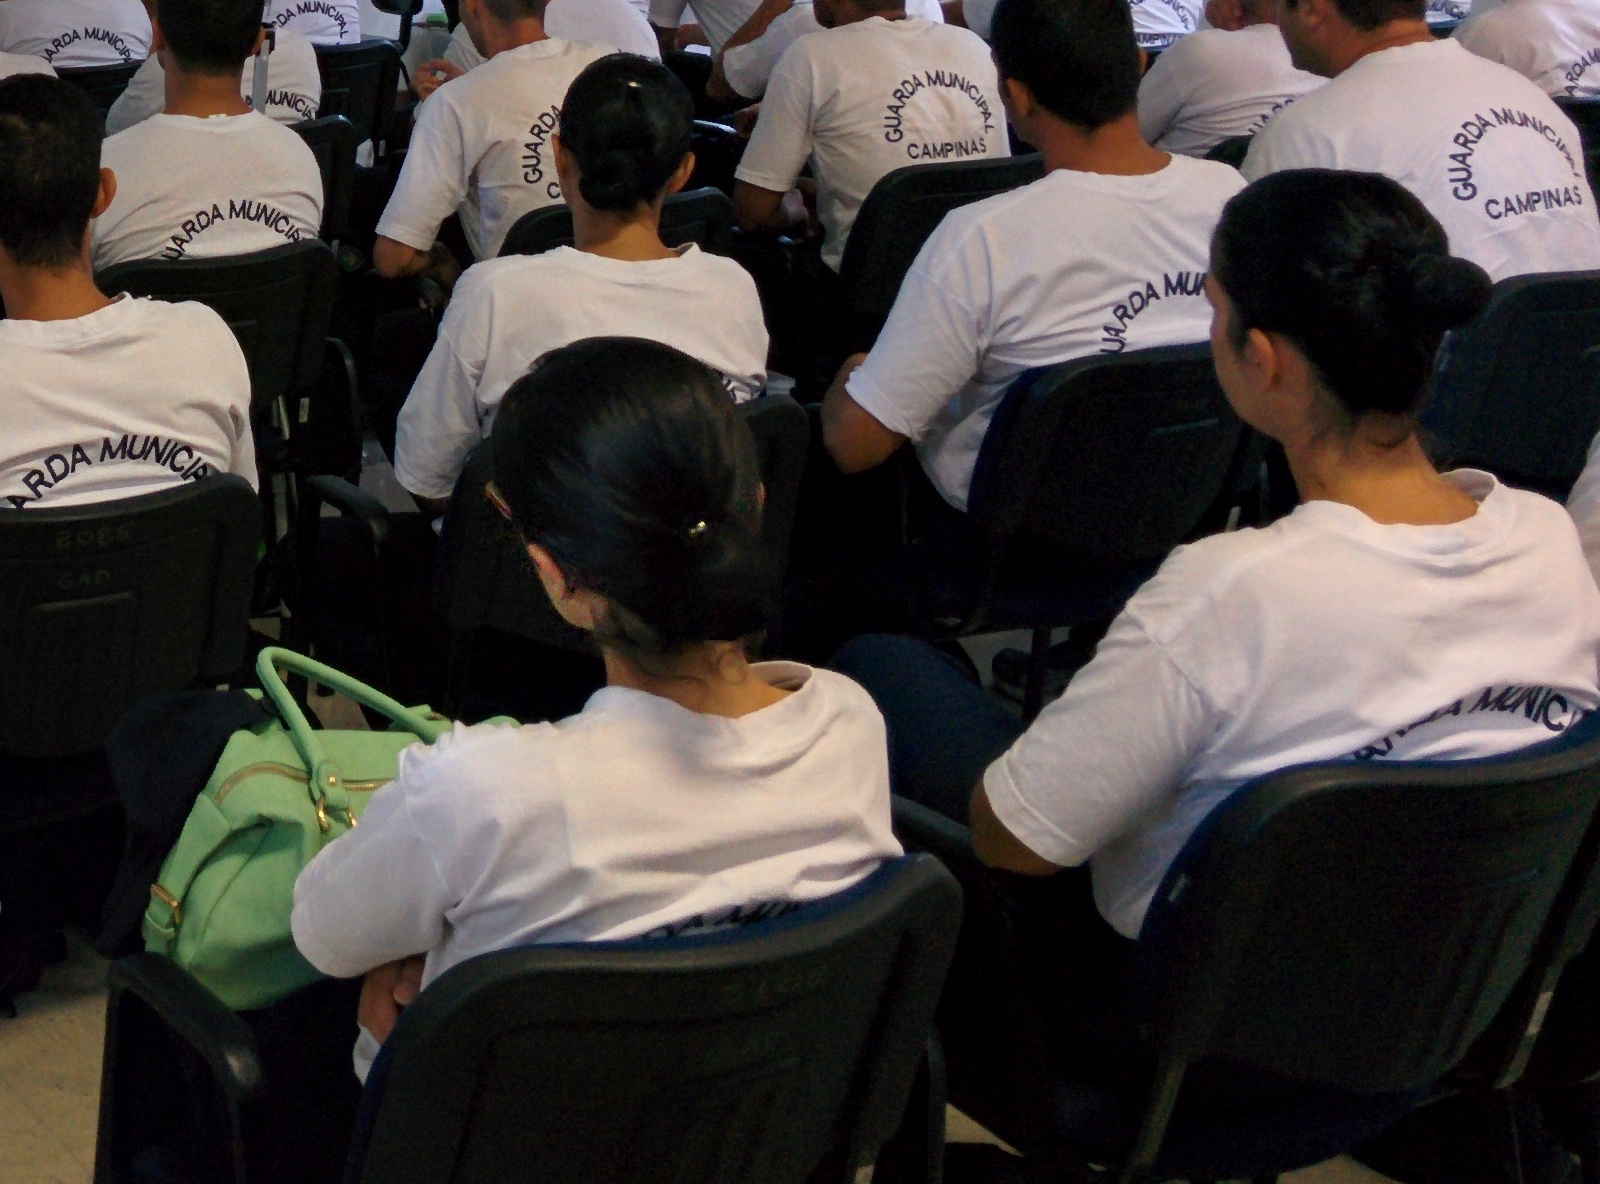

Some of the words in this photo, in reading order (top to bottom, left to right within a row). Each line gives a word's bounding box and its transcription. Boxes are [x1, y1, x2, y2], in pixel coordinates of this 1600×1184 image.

[296, 0, 349, 39] MUNICIPAL
[41, 29, 82, 64] ARDA
[1564, 55, 1592, 97] ARDA
[884, 73, 926, 143] GUARDA
[924, 69, 995, 135] MUNICIPAL
[907, 137, 987, 159] CAMPINAS
[1447, 113, 1497, 201] GUARDA
[1484, 185, 1583, 220] CAMPINAS
[161, 203, 225, 260] UARDA
[228, 199, 301, 244] MUNICIP
[1099, 281, 1162, 353] UARDA
[6, 443, 93, 509] ARDA
[99, 434, 209, 482] MUNICIP
